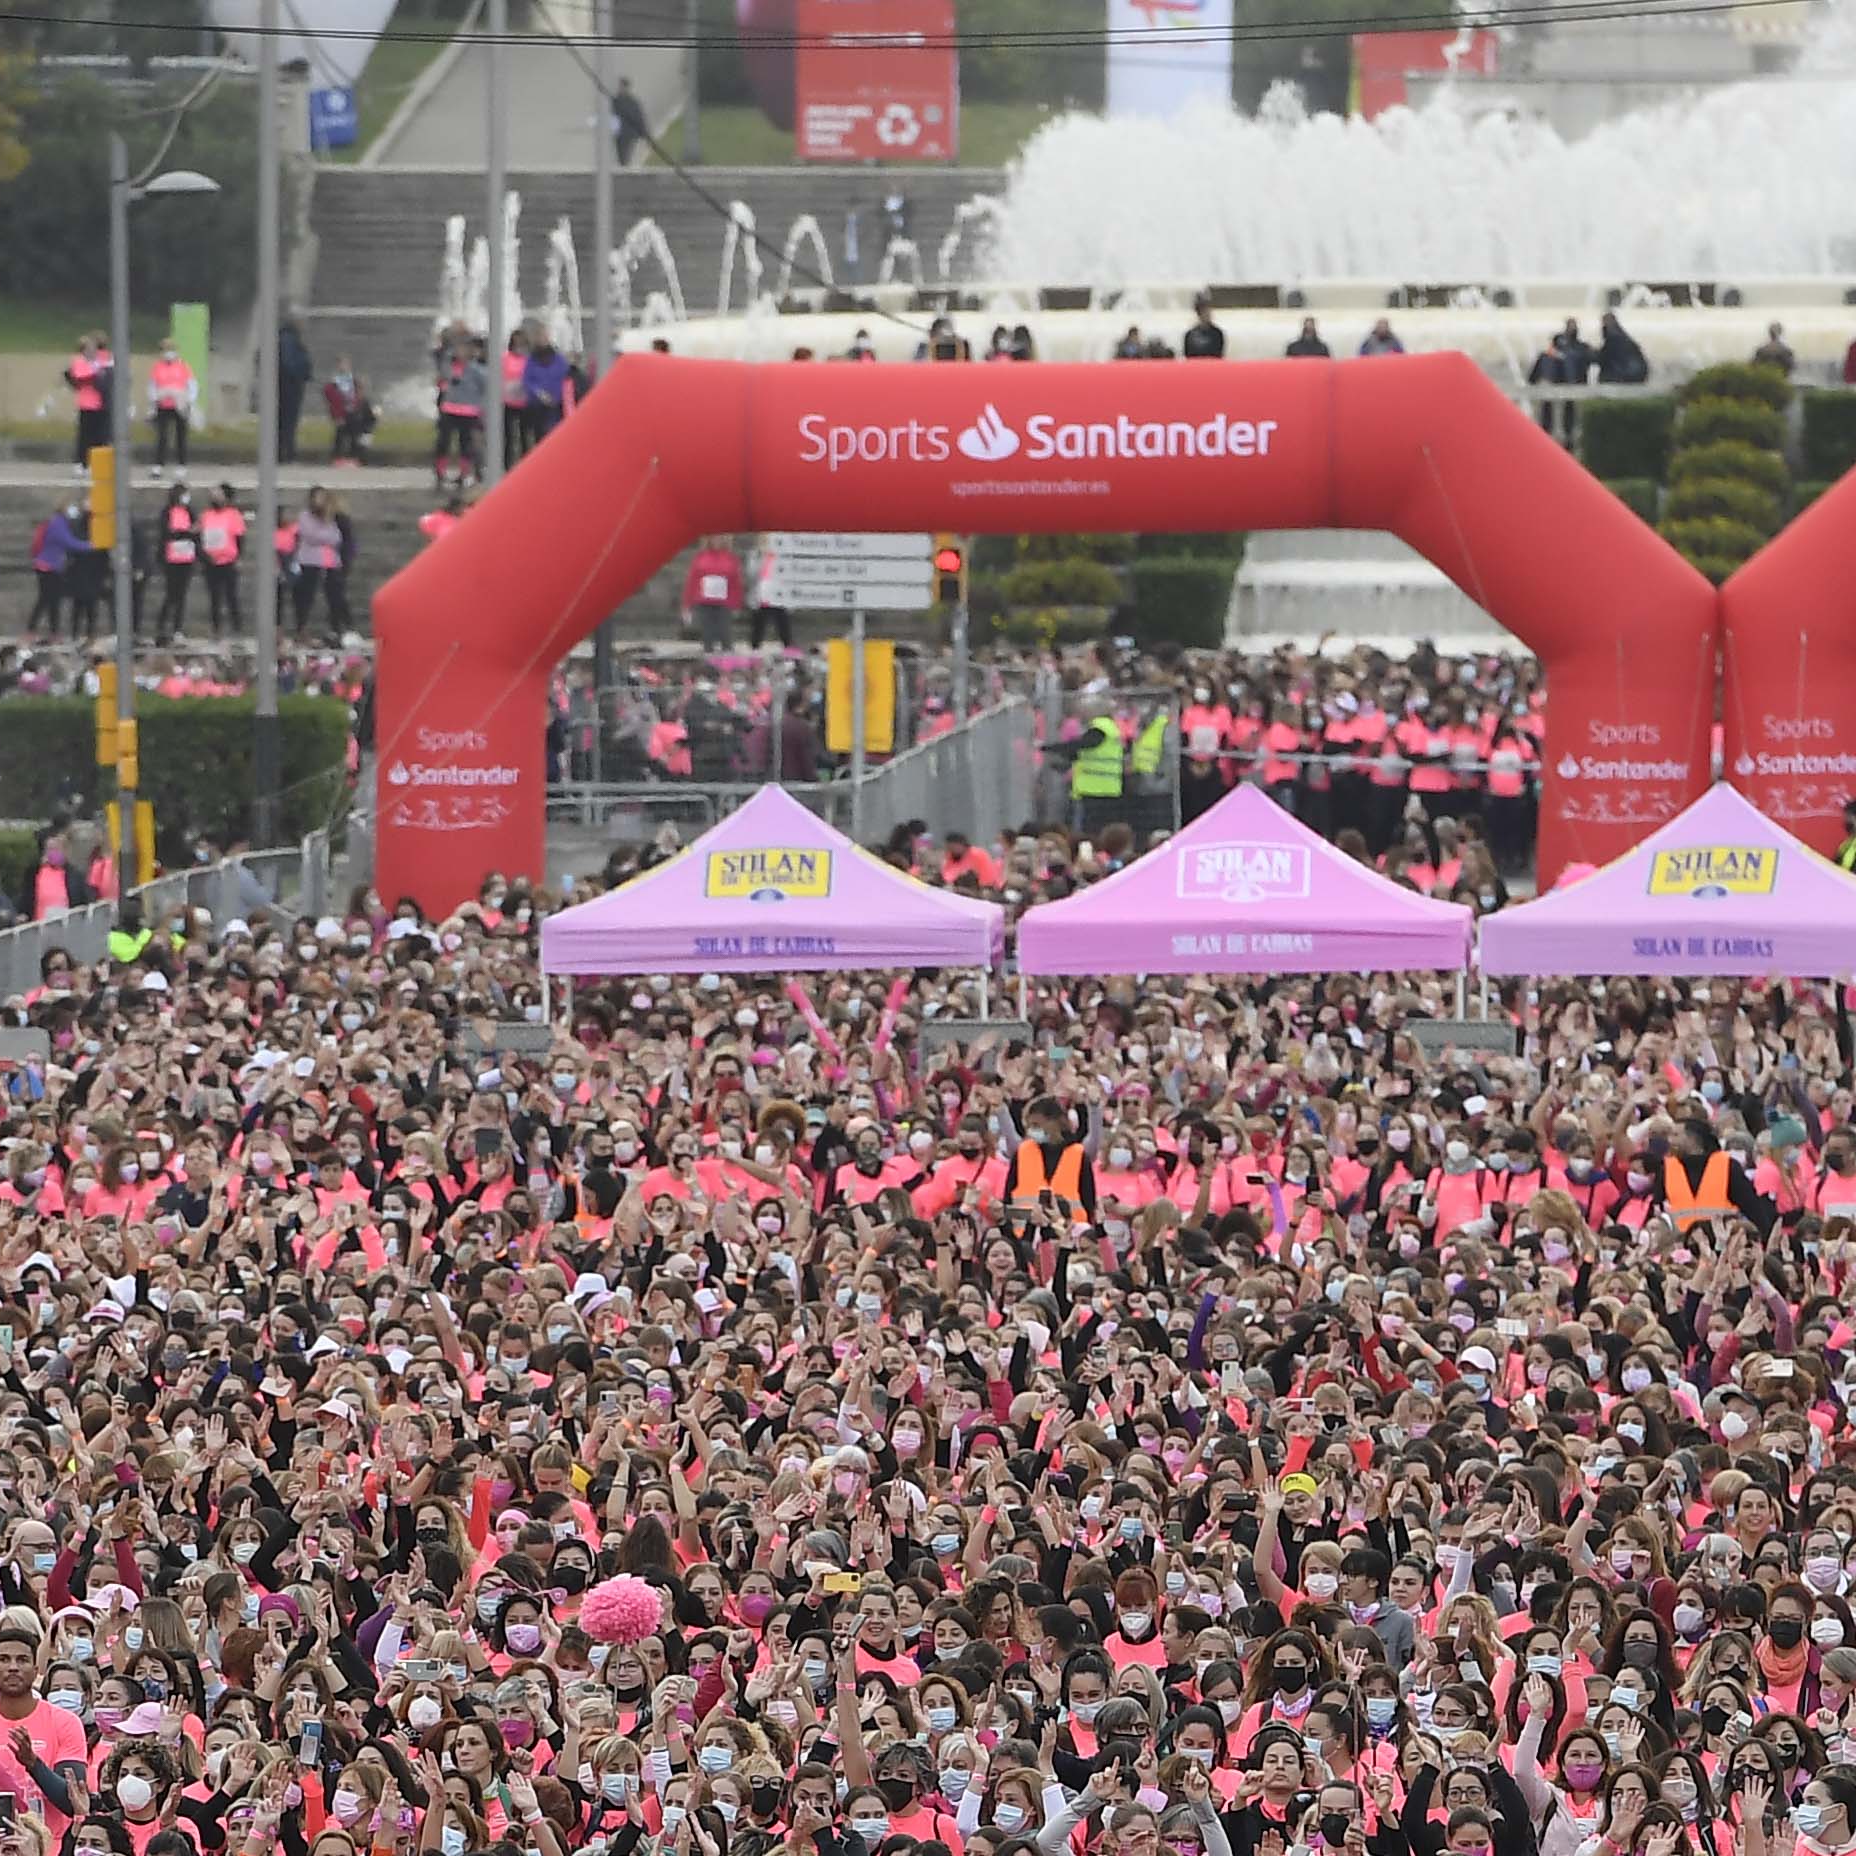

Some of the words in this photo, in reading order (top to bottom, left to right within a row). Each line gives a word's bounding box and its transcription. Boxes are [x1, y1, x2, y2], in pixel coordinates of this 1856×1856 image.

[798, 413, 950, 472] Sports
[1025, 413, 1277, 460] Santander
[416, 728, 488, 752] Sports
[1588, 720, 1661, 746] Sports
[1763, 716, 1835, 741] Sports
[409, 763, 520, 785] Santander
[1579, 758, 1689, 780] Santander
